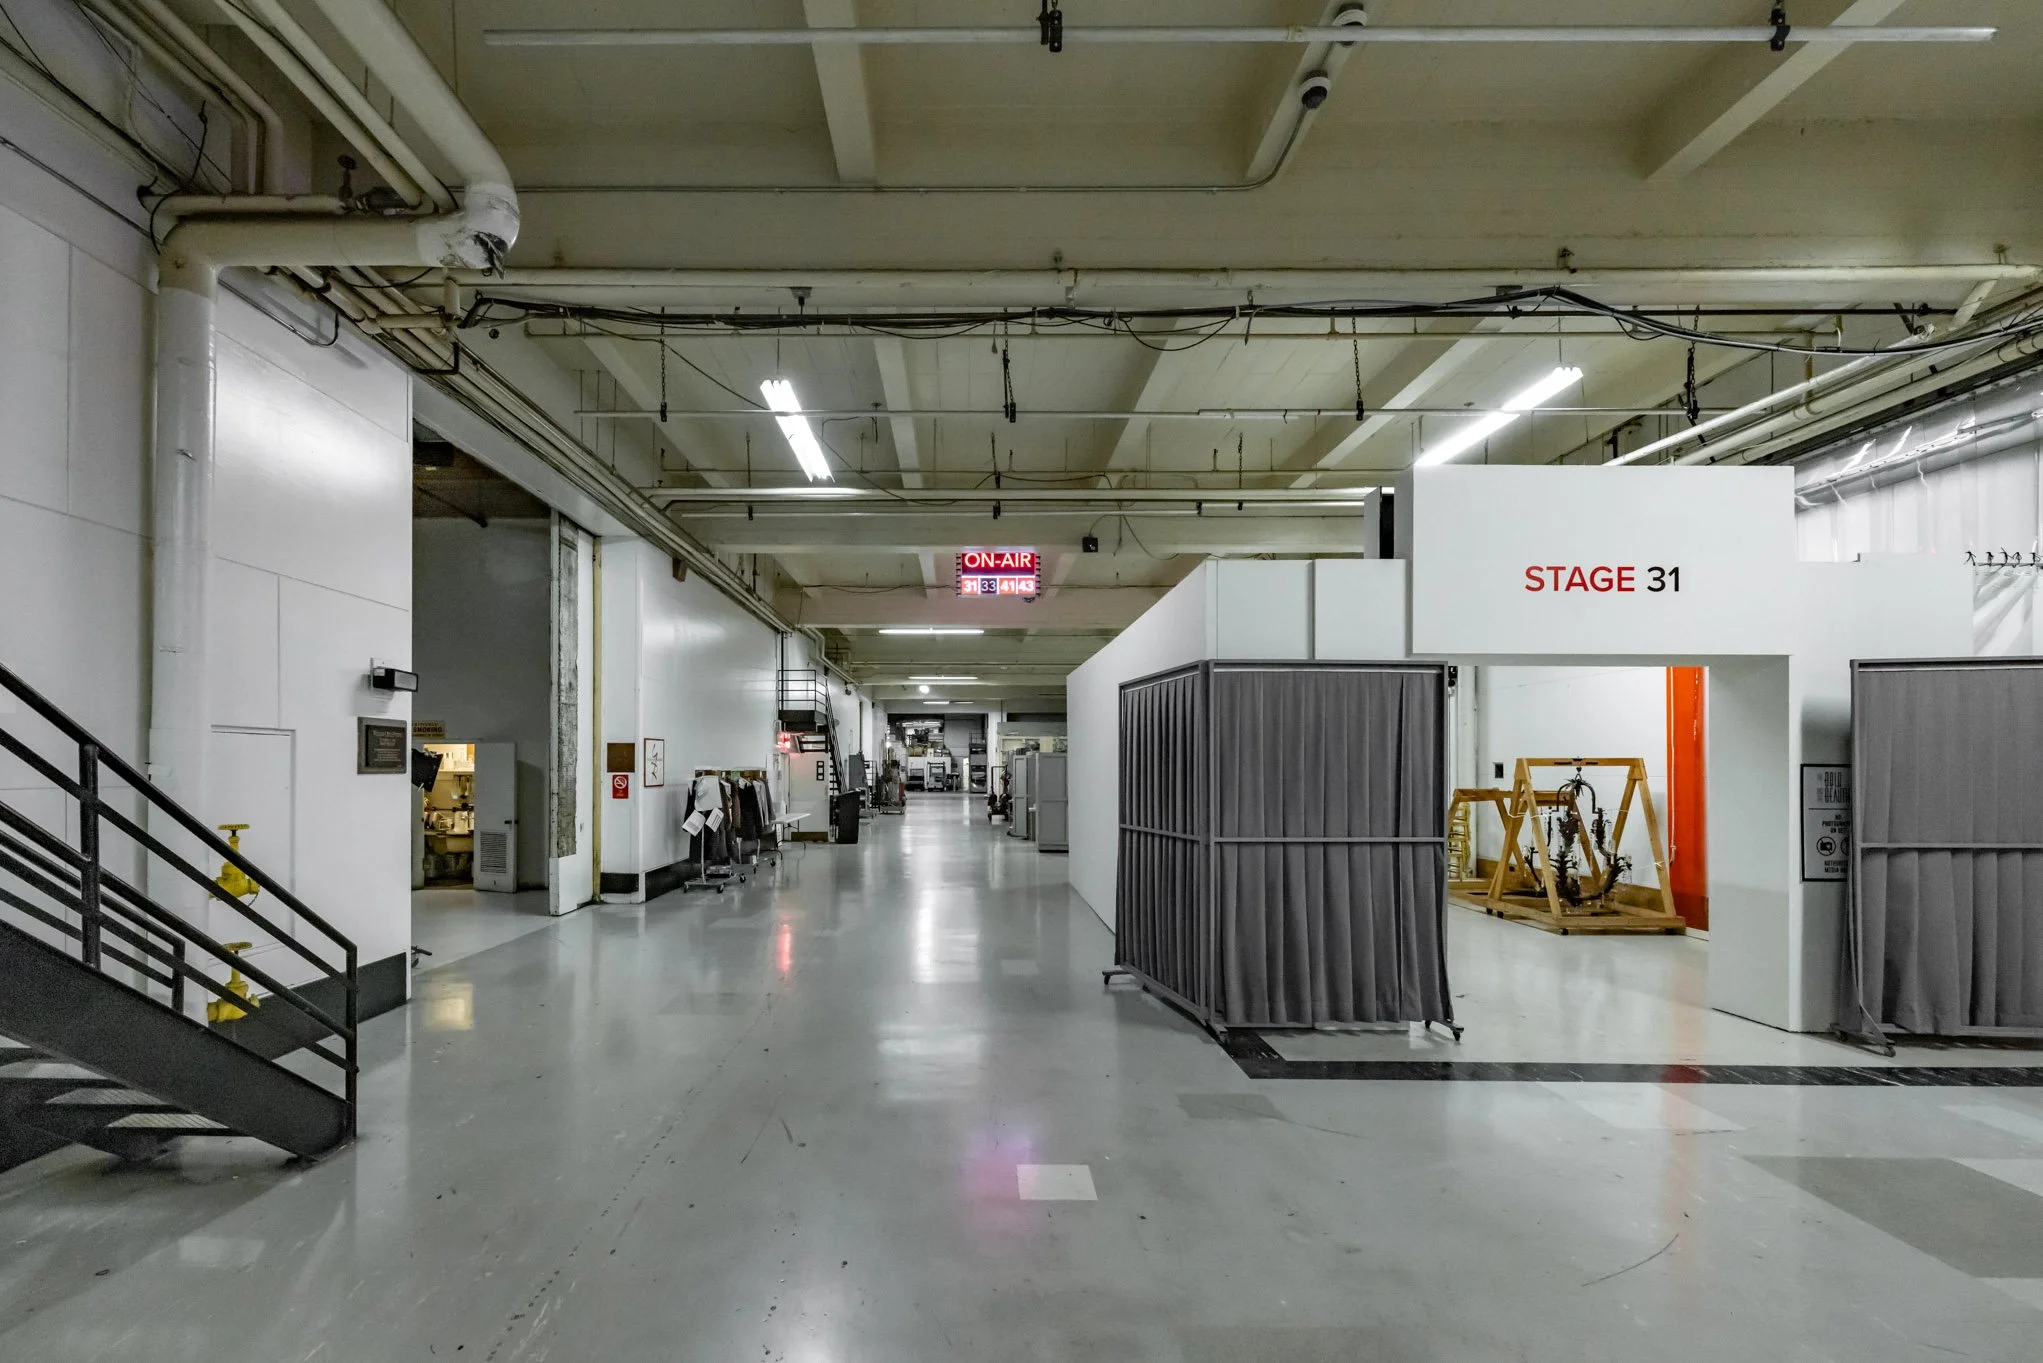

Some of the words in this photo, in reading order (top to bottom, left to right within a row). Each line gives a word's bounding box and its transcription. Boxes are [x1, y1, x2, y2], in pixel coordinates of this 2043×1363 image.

[964, 552, 1031, 568] ON-AIR
[964, 580, 977, 592] 31
[981, 580, 996, 592] 33
[1000, 580, 1016, 592] 41
[1018, 580, 1034, 592] 43
[1525, 566, 1635, 592] STAGE
[1647, 566, 1680, 592] 31
